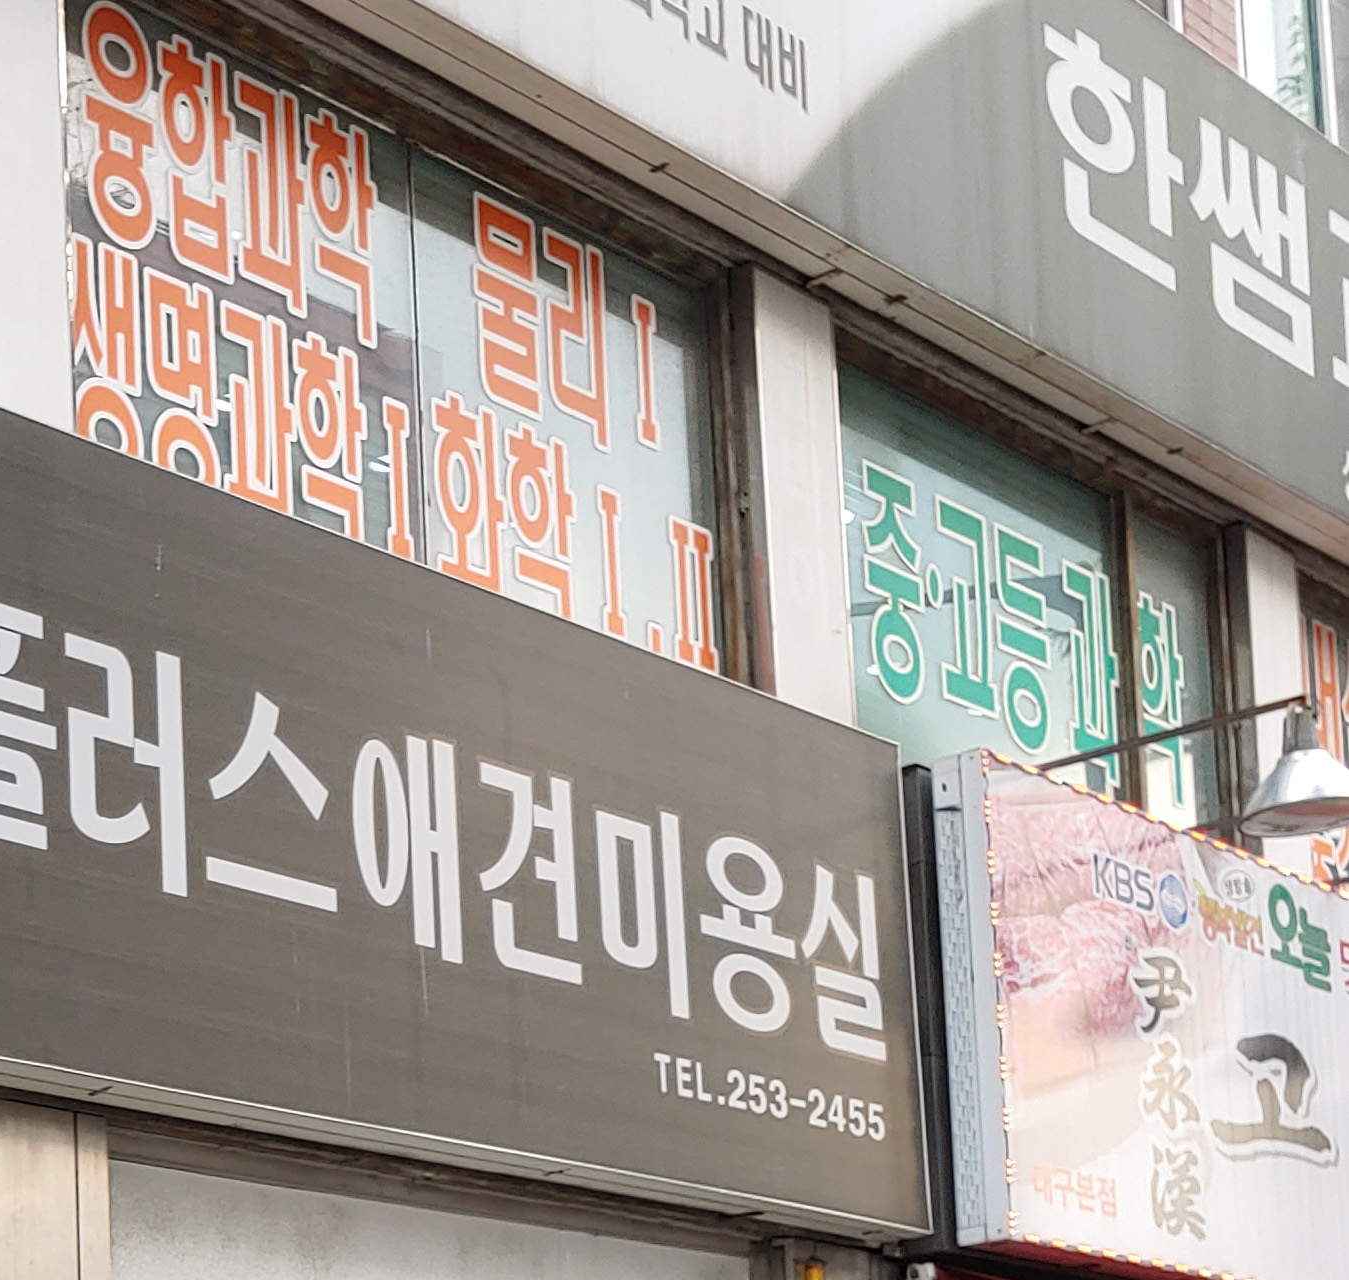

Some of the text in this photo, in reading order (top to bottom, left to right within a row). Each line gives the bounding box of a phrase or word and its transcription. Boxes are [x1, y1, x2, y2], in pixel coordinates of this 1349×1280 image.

[743, 5, 808, 114] 대비
[80, 5, 377, 348] 융합과학
[1043, 24, 1349, 380] 한쌤
[473, 193, 611, 450] 물리
[431, 391, 574, 620] 화학
[1093, 853, 1154, 912] KBS
[1268, 884, 1332, 993] 오늘
[654, 1052, 887, 1142] TEL.253-2455
[1034, 1162, 1118, 1218] 대구본점
